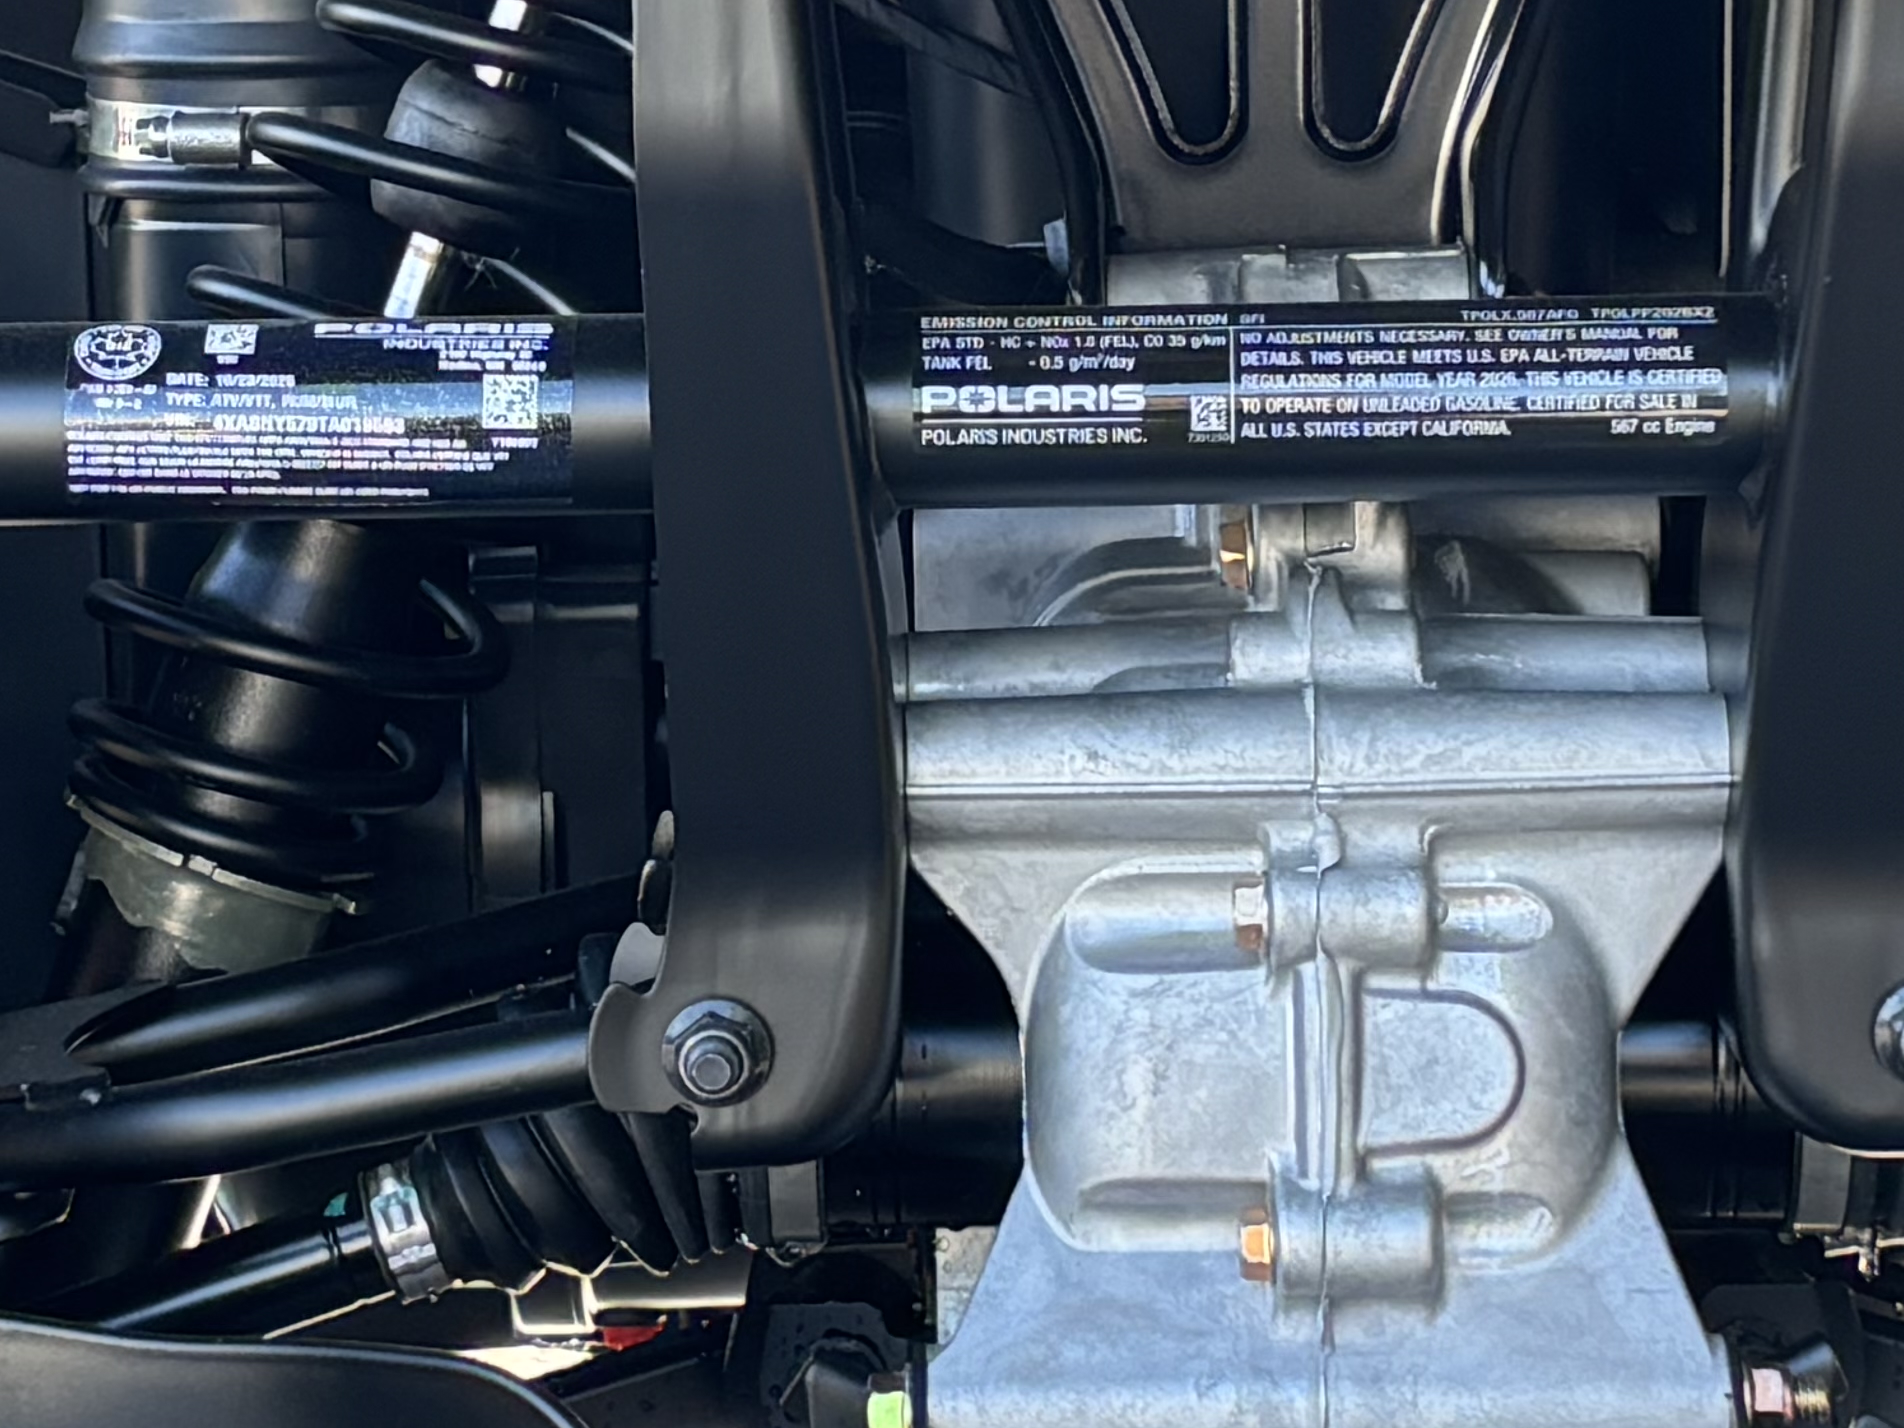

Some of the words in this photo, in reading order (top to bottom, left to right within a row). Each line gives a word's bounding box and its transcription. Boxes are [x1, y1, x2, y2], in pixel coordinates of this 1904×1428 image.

[314, 322, 555, 335] POLARIS
[920, 316, 1008, 329] EMISSION
[1013, 315, 1097, 328] CONTROL
[1102, 313, 1228, 327] INFORMATION
[922, 336, 950, 350] EPA
[955, 336, 985, 350] STD
[1000, 336, 1022, 349] HC
[1040, 335, 1069, 349] NOx
[1240, 331, 1262, 345] NO
[1266, 330, 1375, 345] ADJUSTMENTS
[1379, 329, 1471, 344] NECESSARY.
[1474, 328, 1504, 343] SEE
[1581, 327, 1643, 340] MANUAL
[1647, 326, 1679, 340] FOR
[921, 355, 962, 370] TANK
[1039, 355, 1064, 370] 0.5
[1240, 350, 1304, 367] DETAILS.
[1309, 349, 1344, 366] THIS
[1347, 349, 1407, 365] VEHICLE
[1412, 348, 1463, 364] MEETS
[1466, 348, 1496, 364] U.S.
[1499, 347, 1530, 363] EPA
[1533, 346, 1630, 363] ALL-TERRAIN
[1633, 345, 1695, 362] VEHICLE
[166, 372, 209, 387] DATE:
[1240, 373, 1342, 390] REGULATIONS
[1347, 372, 1377, 389] FOR
[1380, 371, 1434, 388] MODEL
[1436, 371, 1476, 388] YEAR
[1525, 370, 1560, 387] THIS
[1563, 369, 1625, 387] VEHICLE
[1628, 369, 1644, 385] IS
[1647, 368, 1723, 385] CERTIFIED
[165, 392, 207, 407] TYPE:
[921, 384, 1146, 414] POLARIS
[1239, 396, 1261, 414] TO
[1265, 396, 1332, 414] OPERATE
[1336, 396, 1359, 413] ON
[1362, 395, 1441, 413] UNLEADED
[1526, 393, 1600, 411] CERTIFIED
[1605, 393, 1636, 410] FOR
[1639, 393, 1677, 410] SALE
[1681, 393, 1697, 409] IN
[1240, 422, 1269, 439] ALL
[1271, 421, 1301, 438] U.S.
[1303, 421, 1360, 438] STATES
[1363, 421, 1419, 437] EXCEPT
[1421, 419, 1512, 437] CALIFORNIA.
[1642, 420, 1661, 434] cc
[1664, 416, 1716, 436] Engine
[921, 428, 998, 446] POLARIS
[1002, 427, 1108, 445] INDUSTRIES
[1111, 427, 1148, 444] INC.
